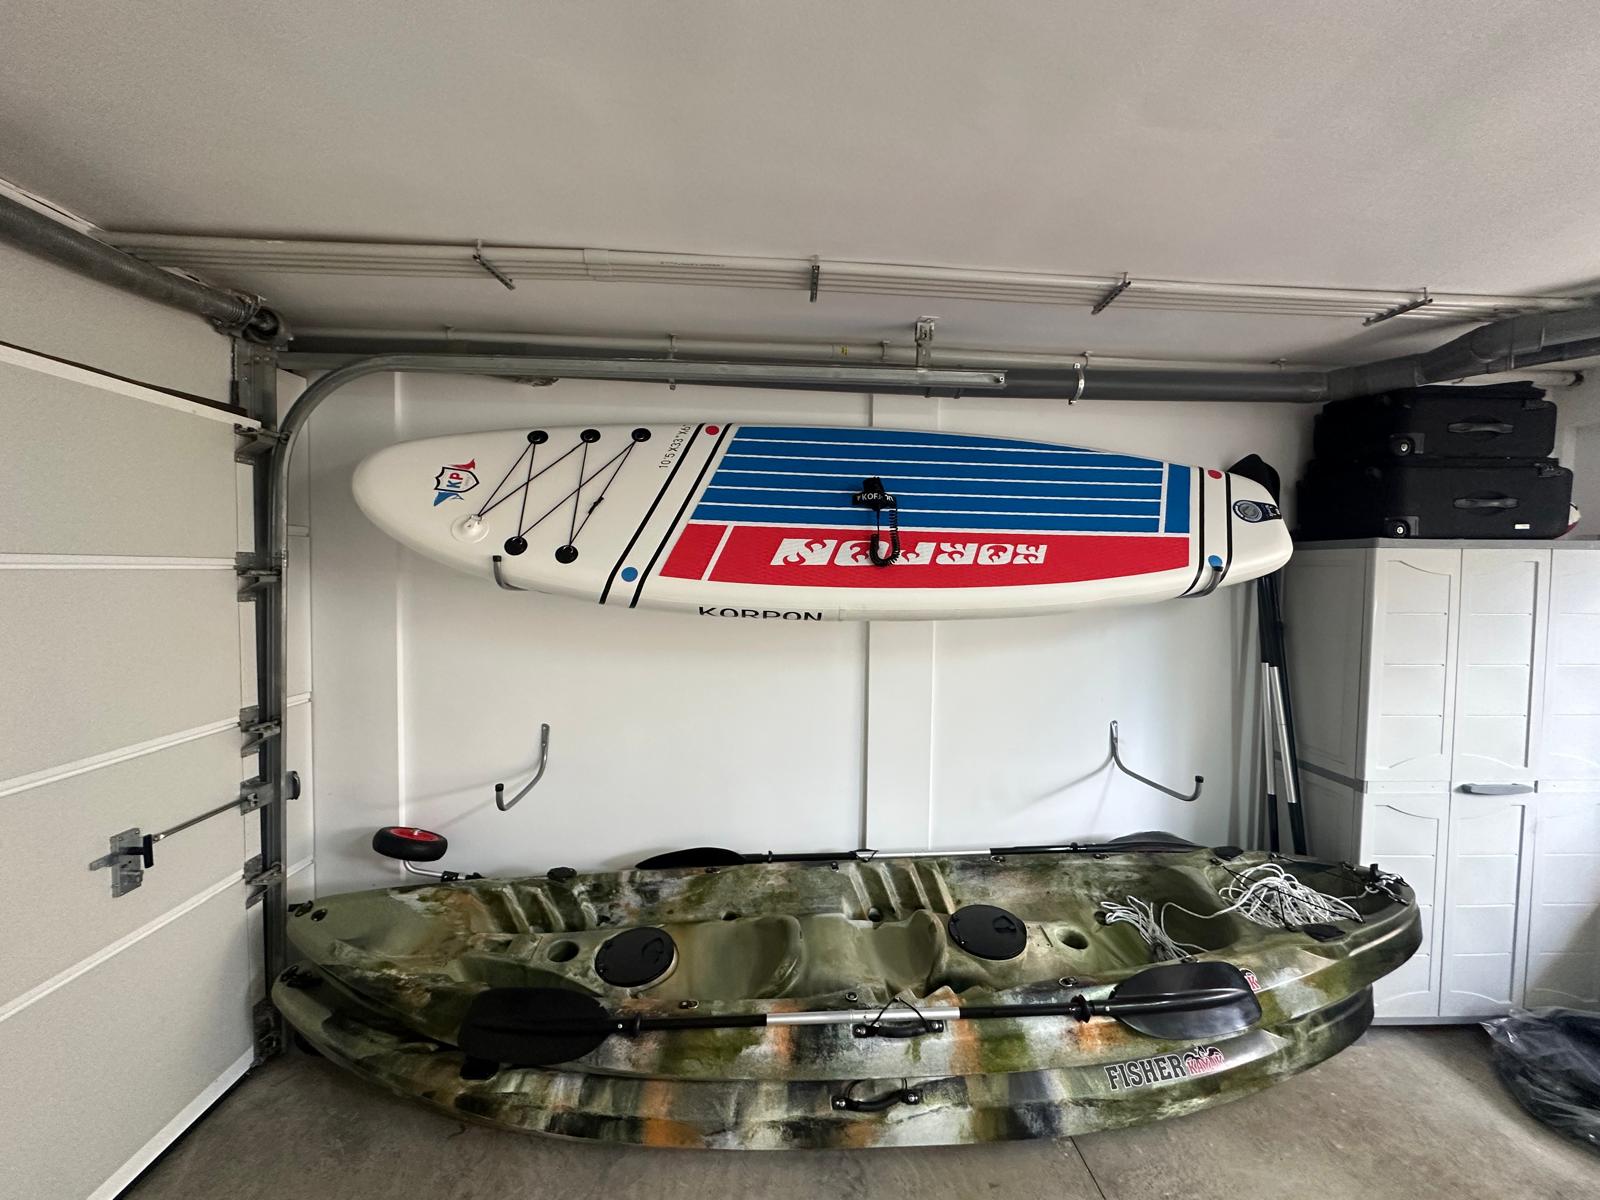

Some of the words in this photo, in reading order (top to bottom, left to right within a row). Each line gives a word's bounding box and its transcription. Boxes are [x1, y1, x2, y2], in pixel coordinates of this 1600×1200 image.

[446, 472, 463, 488] KP
[698, 606, 823, 621] KORPON
[1104, 1054, 1187, 1091] FISHER
